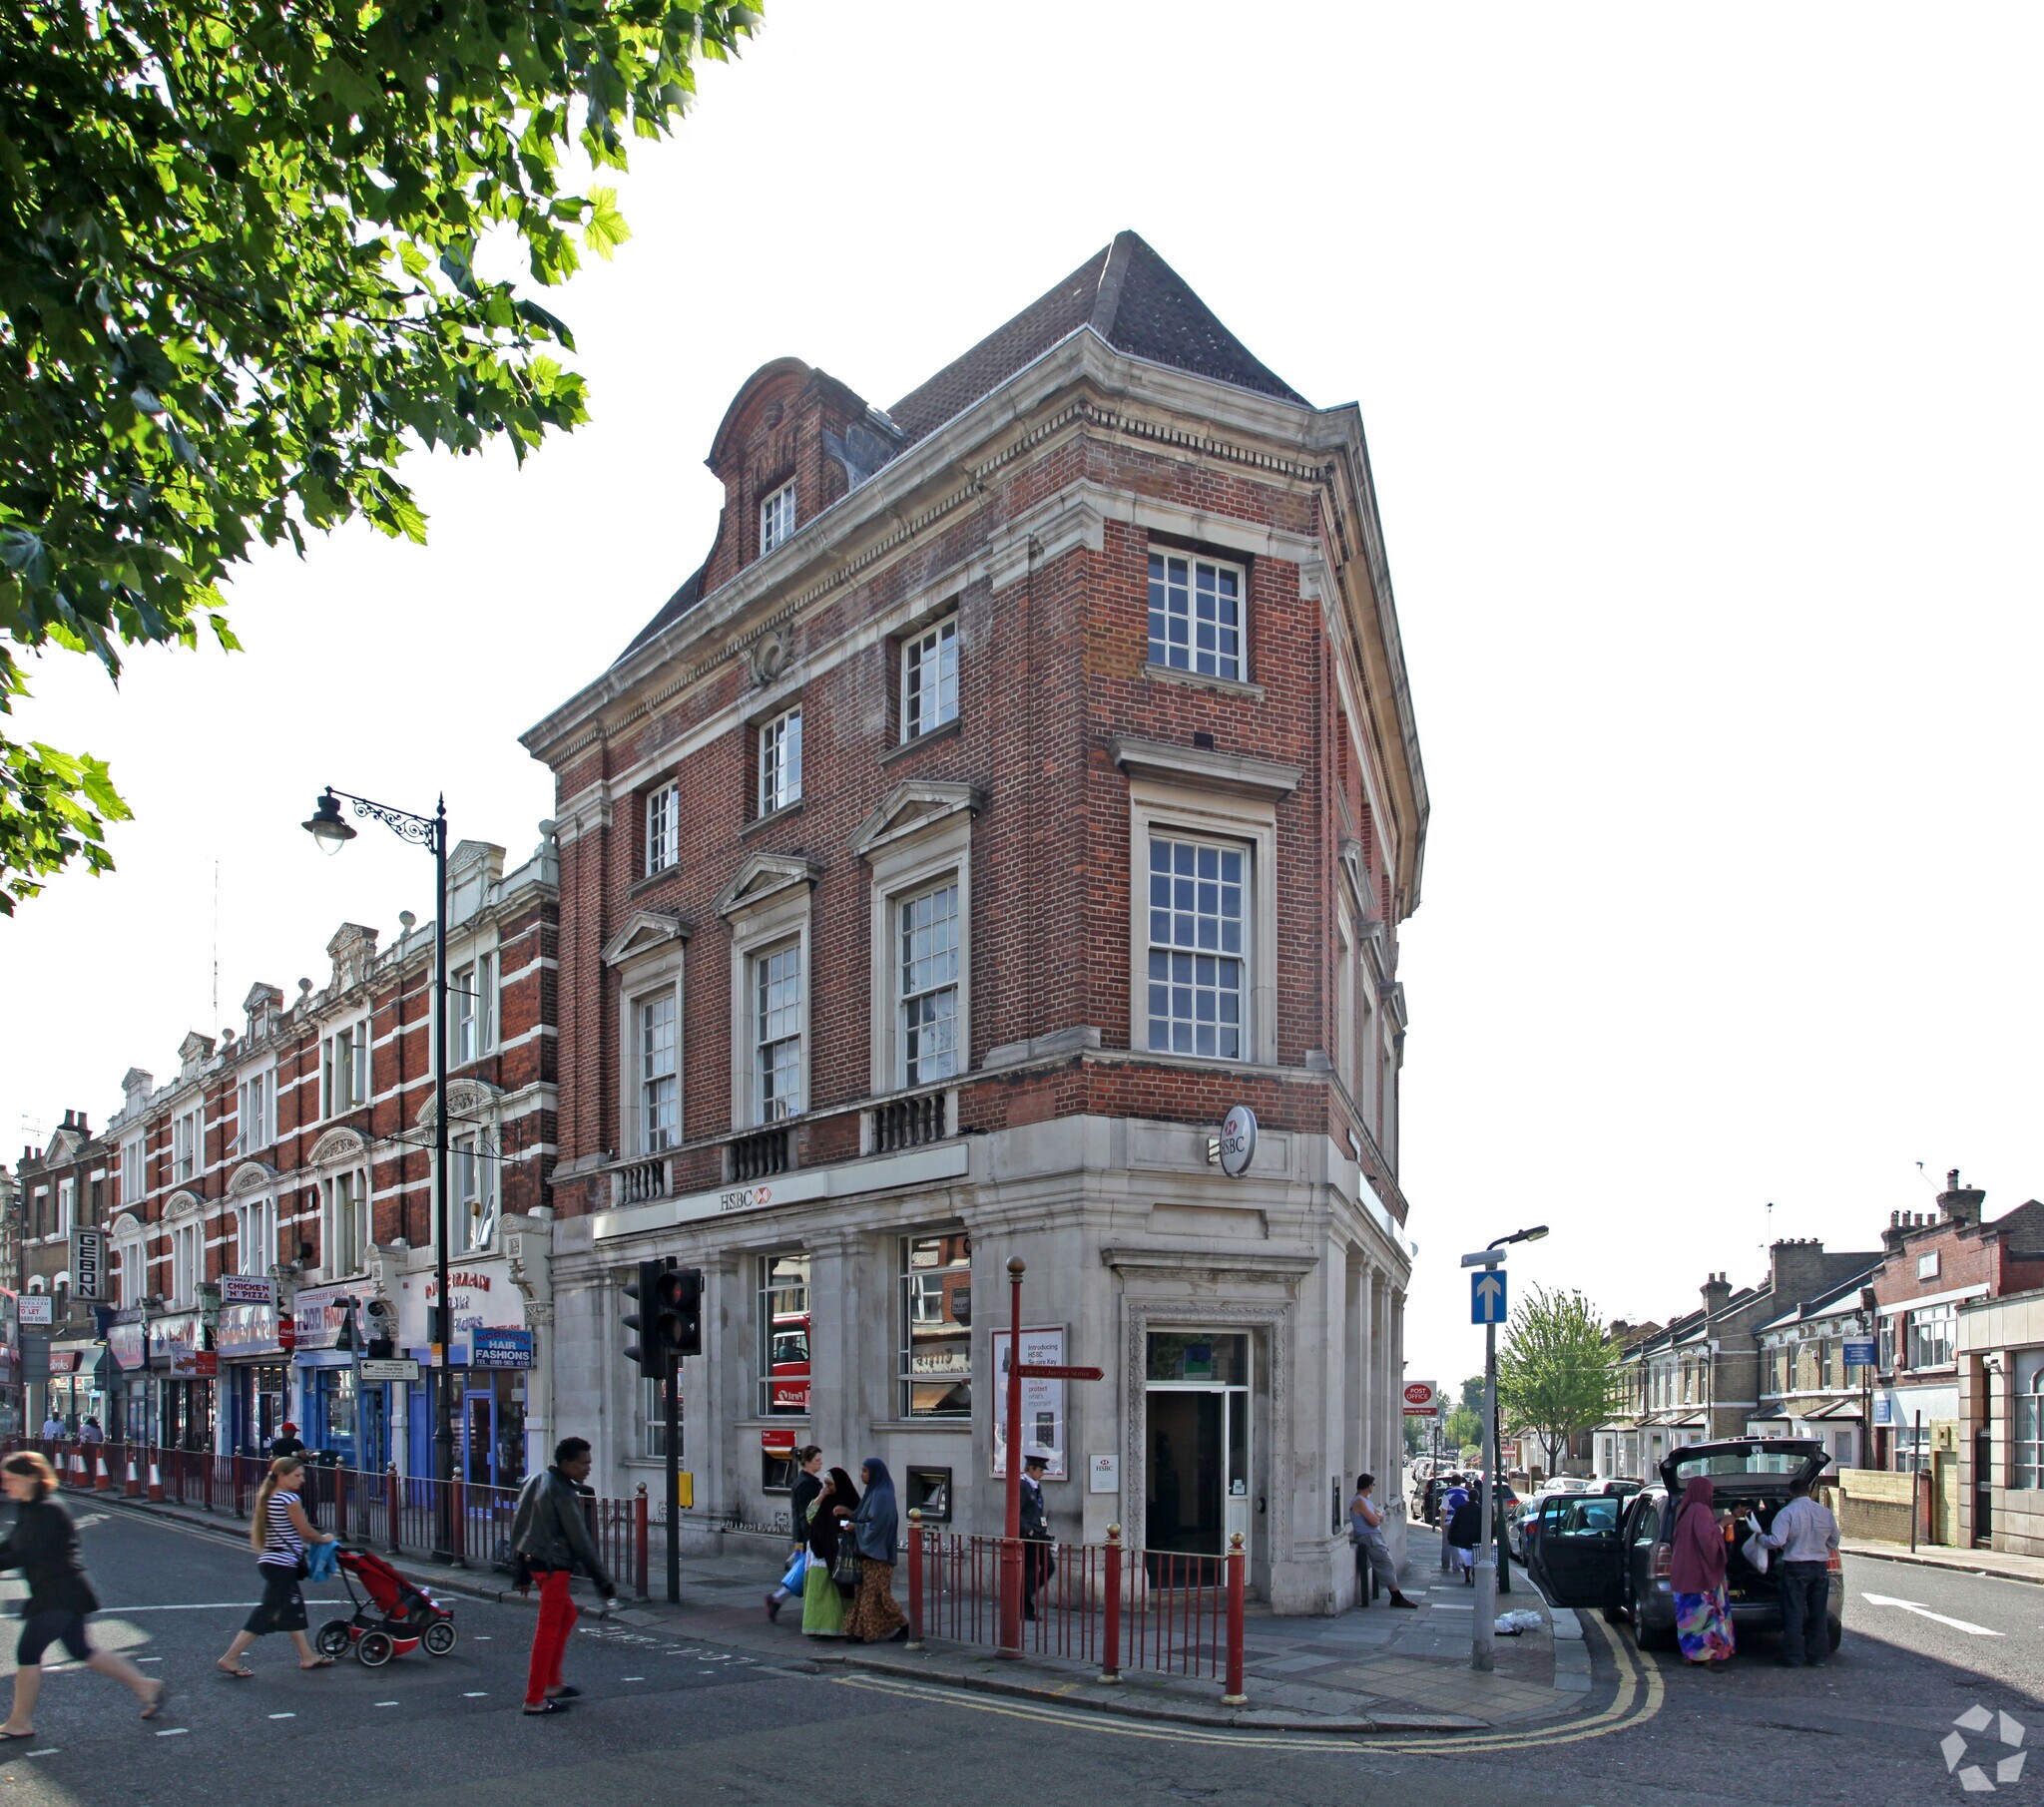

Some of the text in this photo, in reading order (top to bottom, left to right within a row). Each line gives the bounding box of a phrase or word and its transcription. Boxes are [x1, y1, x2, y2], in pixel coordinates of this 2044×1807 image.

[1221, 1136, 1245, 1156] HSBC
[720, 1190, 753, 1211] HSBC
[80, 1233, 96, 1297] GEBON
[228, 1283, 269, 1292] CHICKEN
[297, 1306, 321, 1331] FOOD
[324, 1305, 344, 1328] AND
[476, 1332, 529, 1345] NORMAN
[489, 1340, 517, 1350] HAIR
[475, 1349, 530, 1361] FASHIONS
